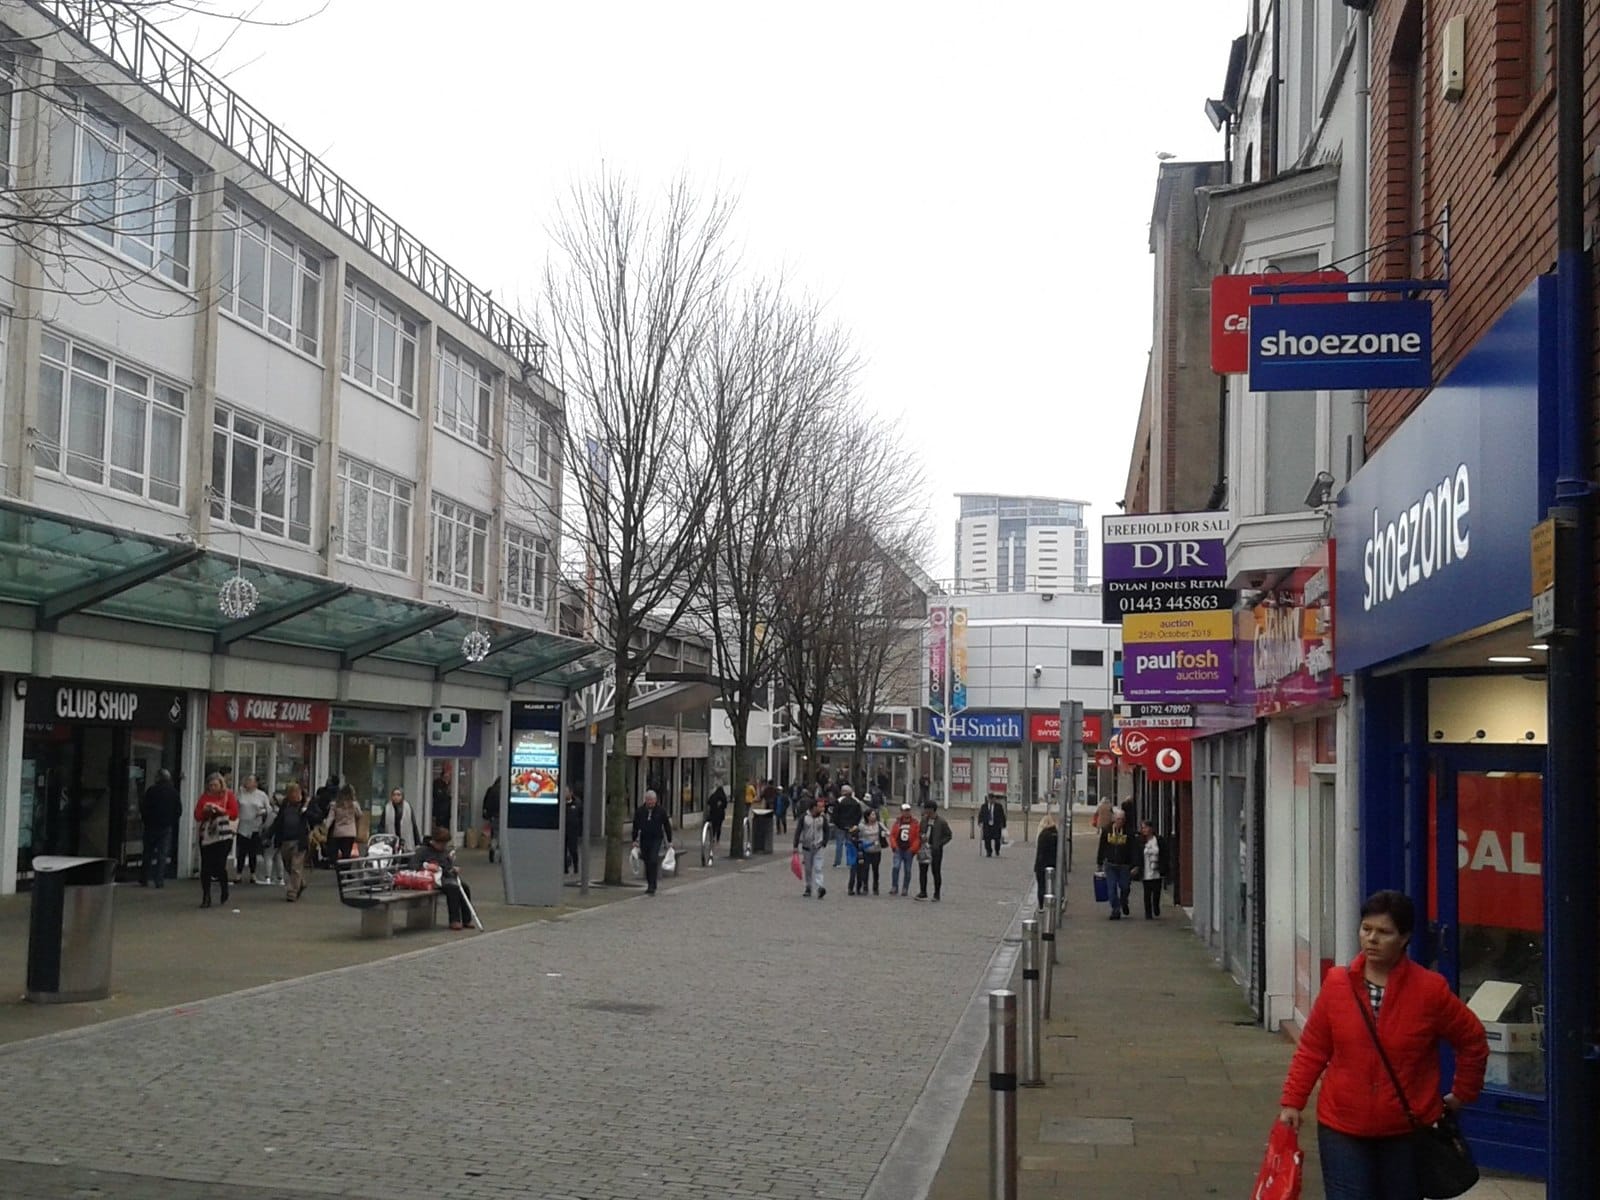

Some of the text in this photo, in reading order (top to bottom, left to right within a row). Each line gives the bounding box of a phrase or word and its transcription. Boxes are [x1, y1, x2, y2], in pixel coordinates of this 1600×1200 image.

[1224, 314, 1248, 331] Ca
[1260, 329, 1421, 356] shoezone
[1107, 523, 1172, 536] FREEHOLD
[1174, 520, 1200, 533] FOR
[1363, 463, 1470, 611] shoezone
[1132, 541, 1208, 575] DJR
[1109, 580, 1224, 592] DYLAN JONES RETAI
[1120, 595, 1218, 611] 01443 445863
[1160, 619, 1194, 628] auction
[1157, 629, 1187, 639] October
[1136, 649, 1219, 674] paulfosh
[1176, 671, 1219, 680] auctions
[56, 688, 138, 720] CLUB SHOP
[244, 699, 312, 721] FONE ZONE
[1140, 704, 1190, 714] 01792 478907
[931, 717, 1019, 737] WHSmith
[990, 767, 1008, 777] SALE
[900, 829, 909, 842] 6
[1458, 828, 1542, 875] AL
